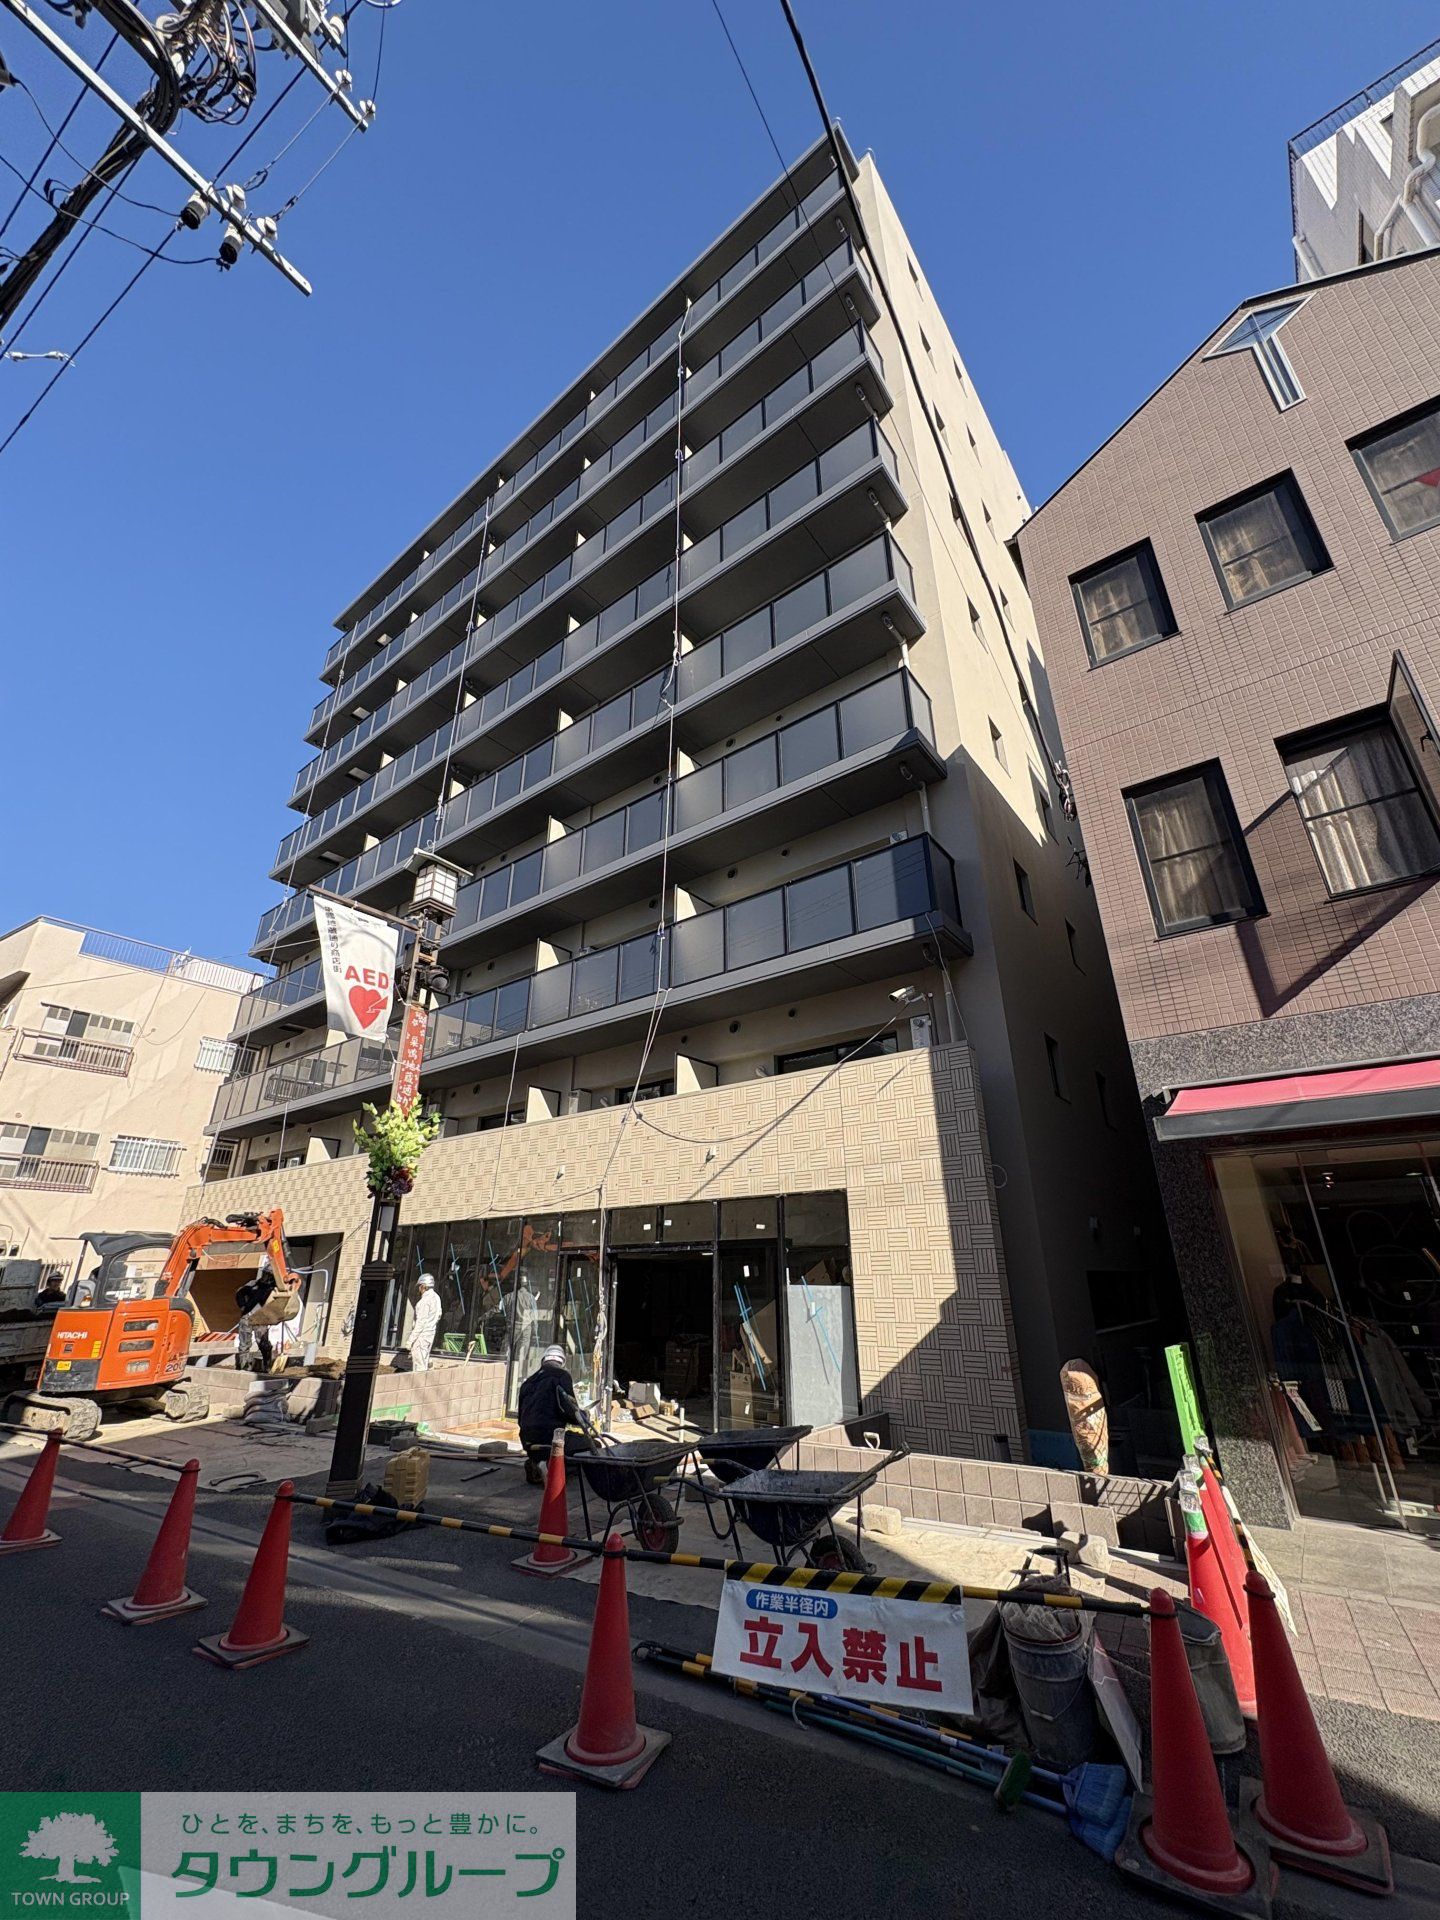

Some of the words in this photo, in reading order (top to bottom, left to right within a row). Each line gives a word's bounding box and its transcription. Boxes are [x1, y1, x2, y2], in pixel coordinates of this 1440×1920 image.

[344, 965, 390, 990] AED
[57, 1331, 88, 1340] HITACHI
[754, 1592, 830, 1617] 作業半径内
[739, 1615, 943, 1693] 立入禁止
